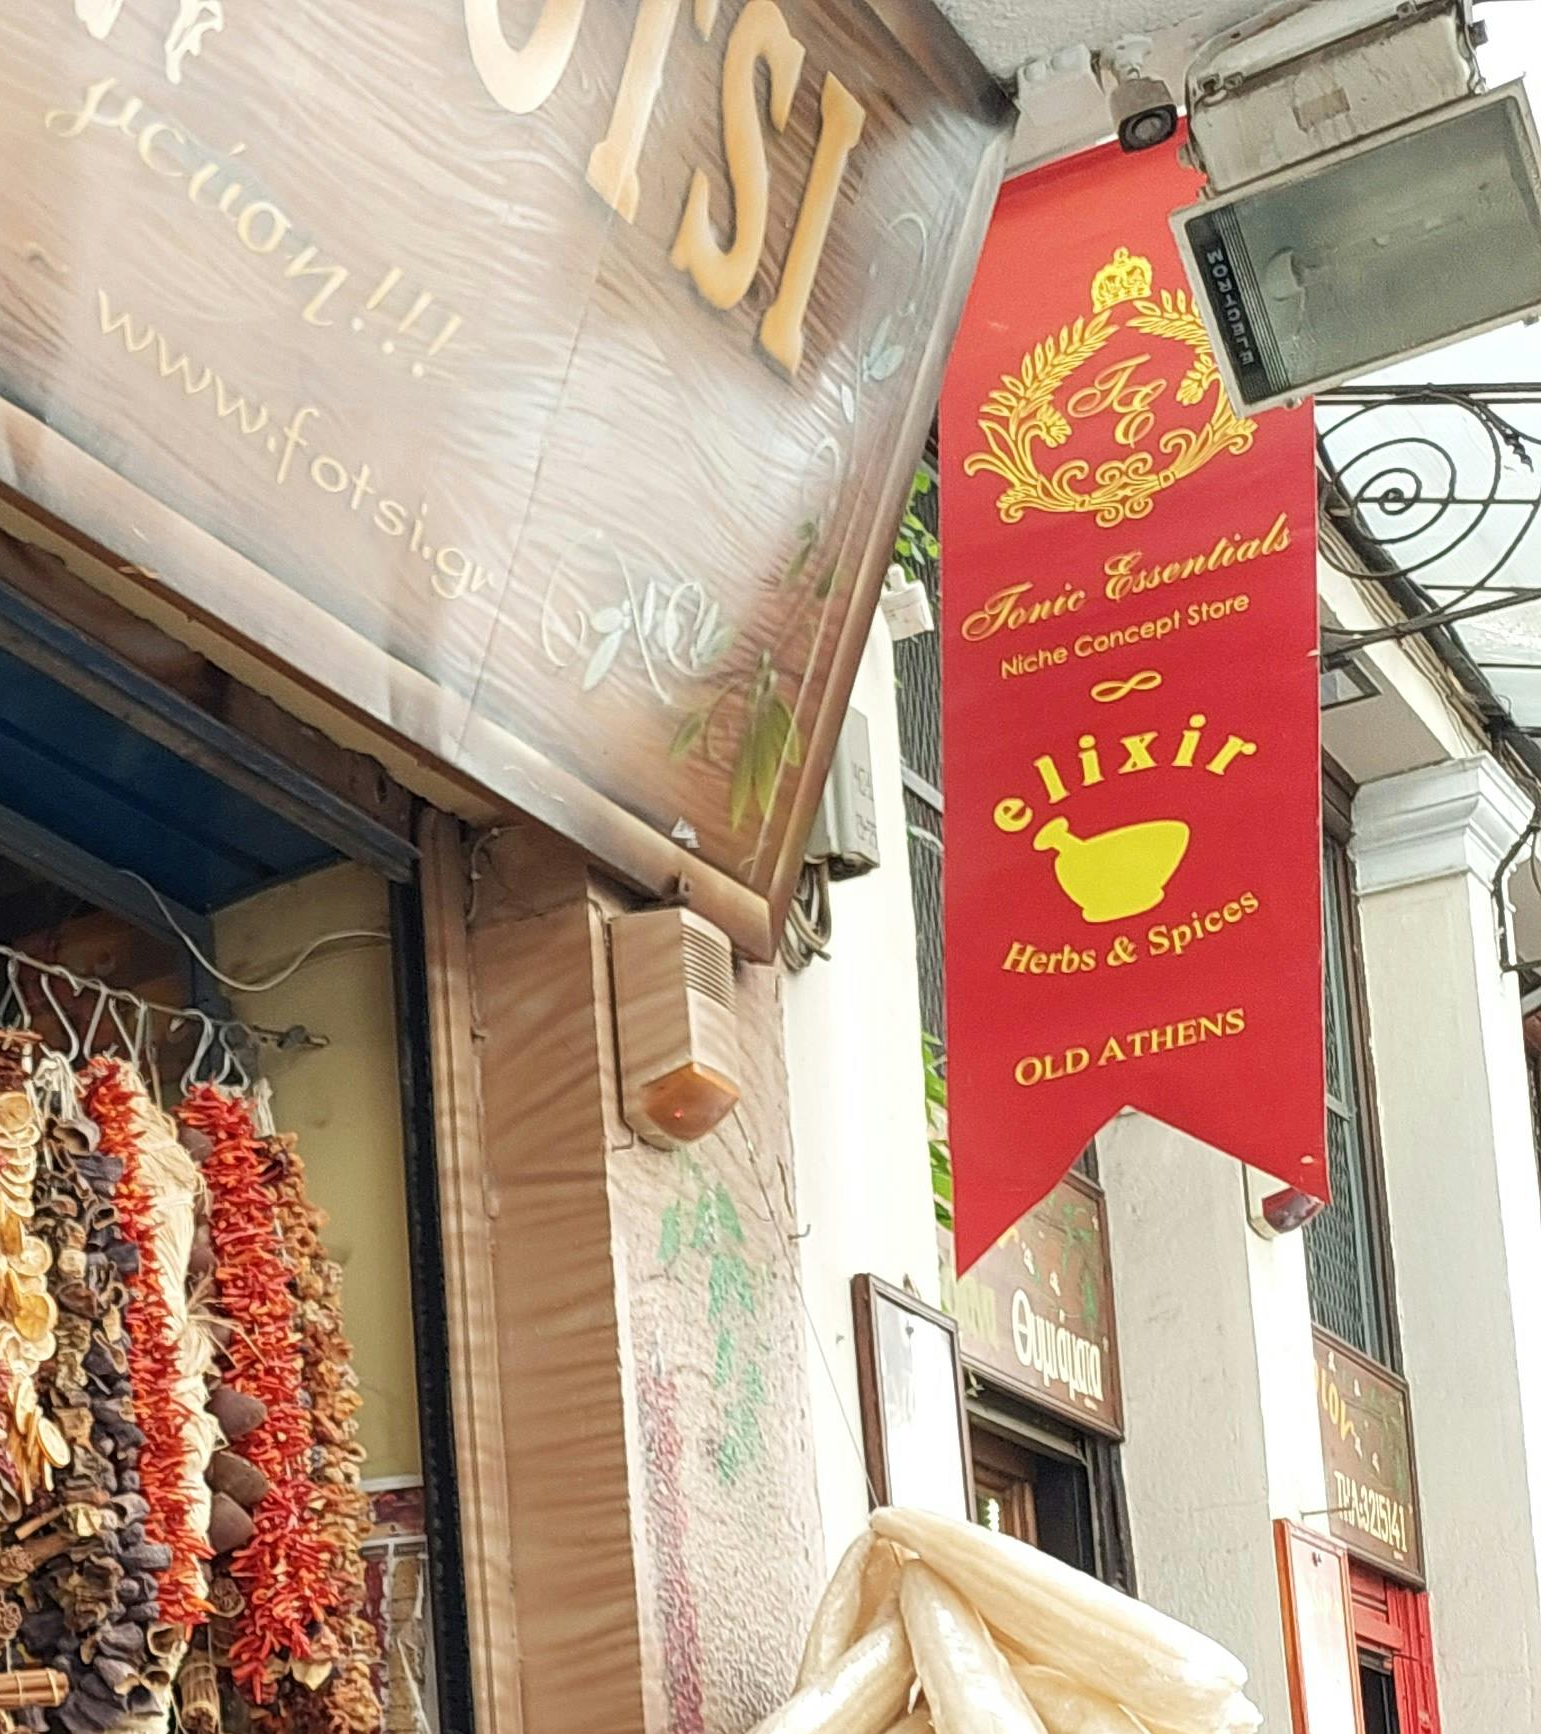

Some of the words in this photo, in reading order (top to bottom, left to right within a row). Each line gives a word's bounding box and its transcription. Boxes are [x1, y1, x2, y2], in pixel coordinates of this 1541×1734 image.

[98, 289, 495, 598] www.fotsi.gr
[962, 582, 1086, 641] Tonic
[1104, 512, 1291, 600] Essentials
[1001, 645, 1068, 679] Niche
[1074, 610, 1180, 657] Concept
[1187, 594, 1250, 626] Store
[993, 714, 1257, 832] elixir
[1002, 941, 1097, 974] Herbs
[1107, 936, 1137, 967] &
[1148, 891, 1259, 955] Spices
[1014, 1048, 1090, 1086] OLD
[1097, 1008, 1246, 1066] ATHENS
